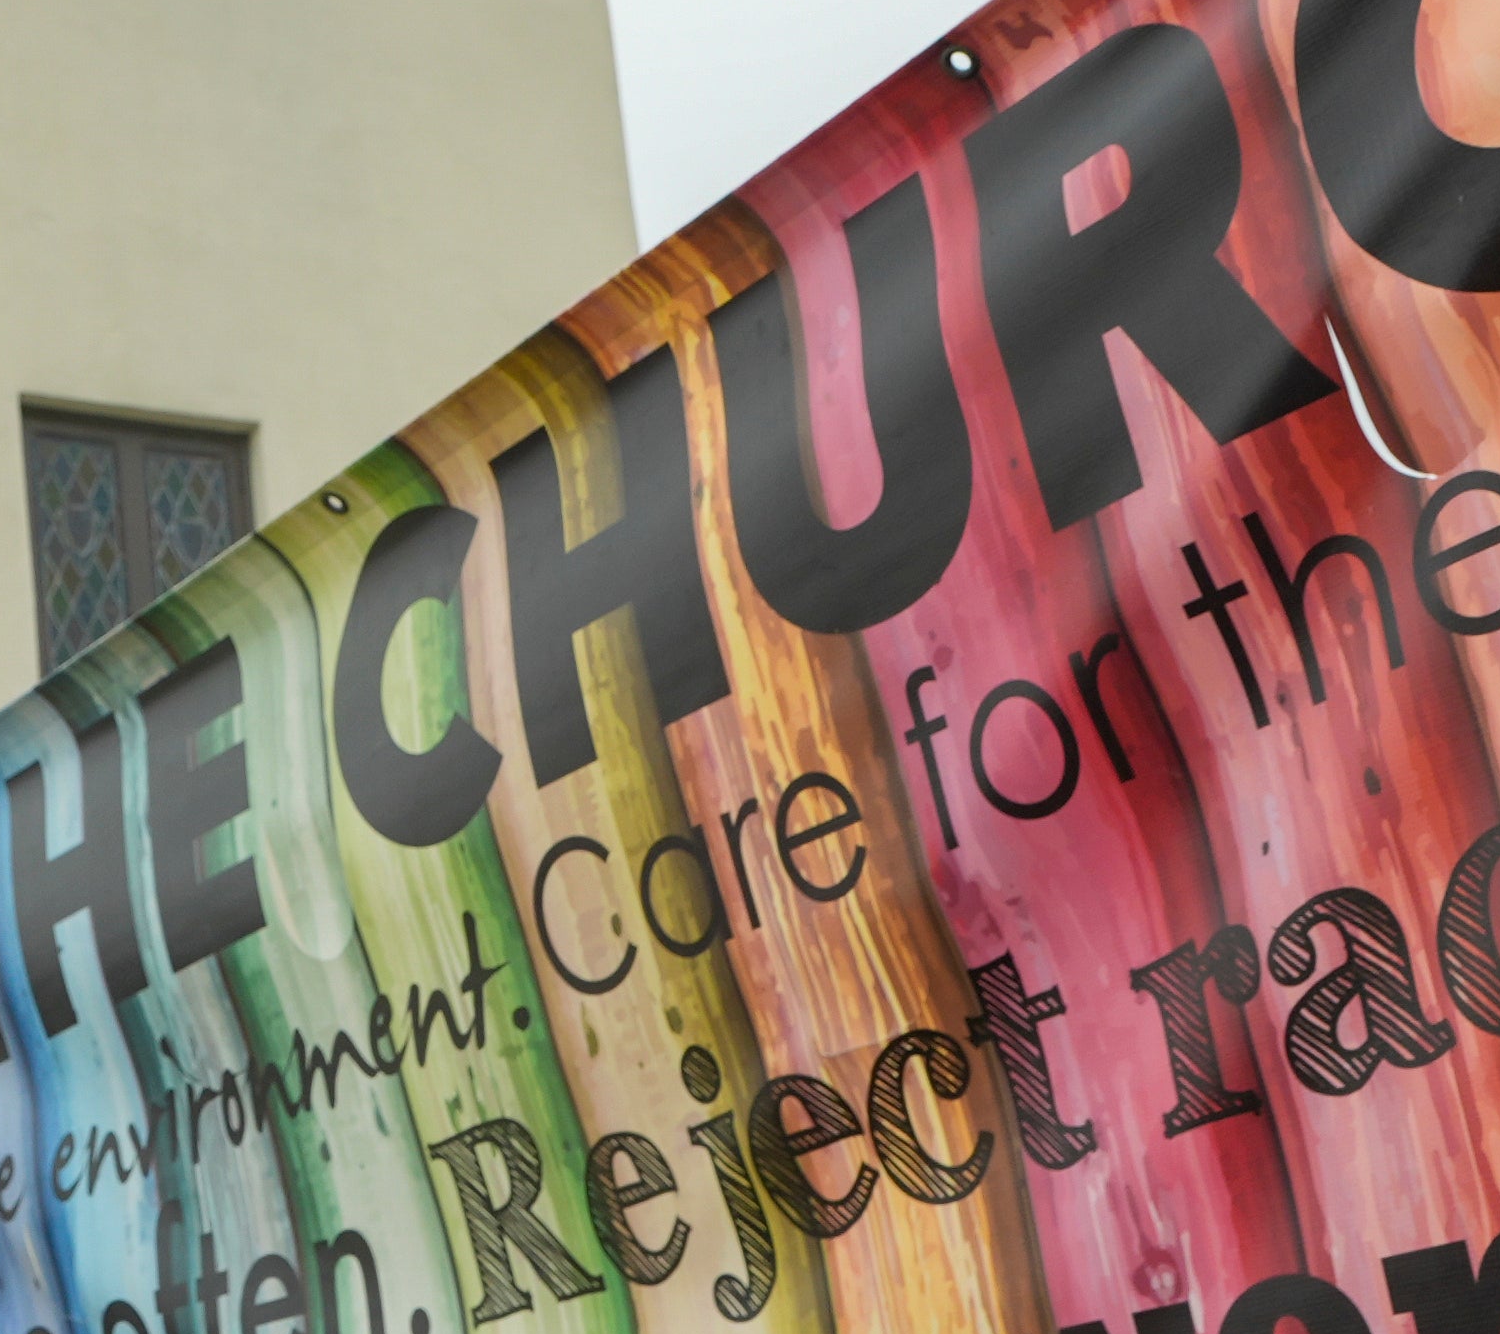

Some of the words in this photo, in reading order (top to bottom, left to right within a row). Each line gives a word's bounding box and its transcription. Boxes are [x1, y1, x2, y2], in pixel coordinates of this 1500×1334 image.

[51, 912, 531, 1203] environment.
[532, 771, 867, 994] Care
[905, 633, 1137, 851] for
[429, 950, 1096, 1326] Reject
